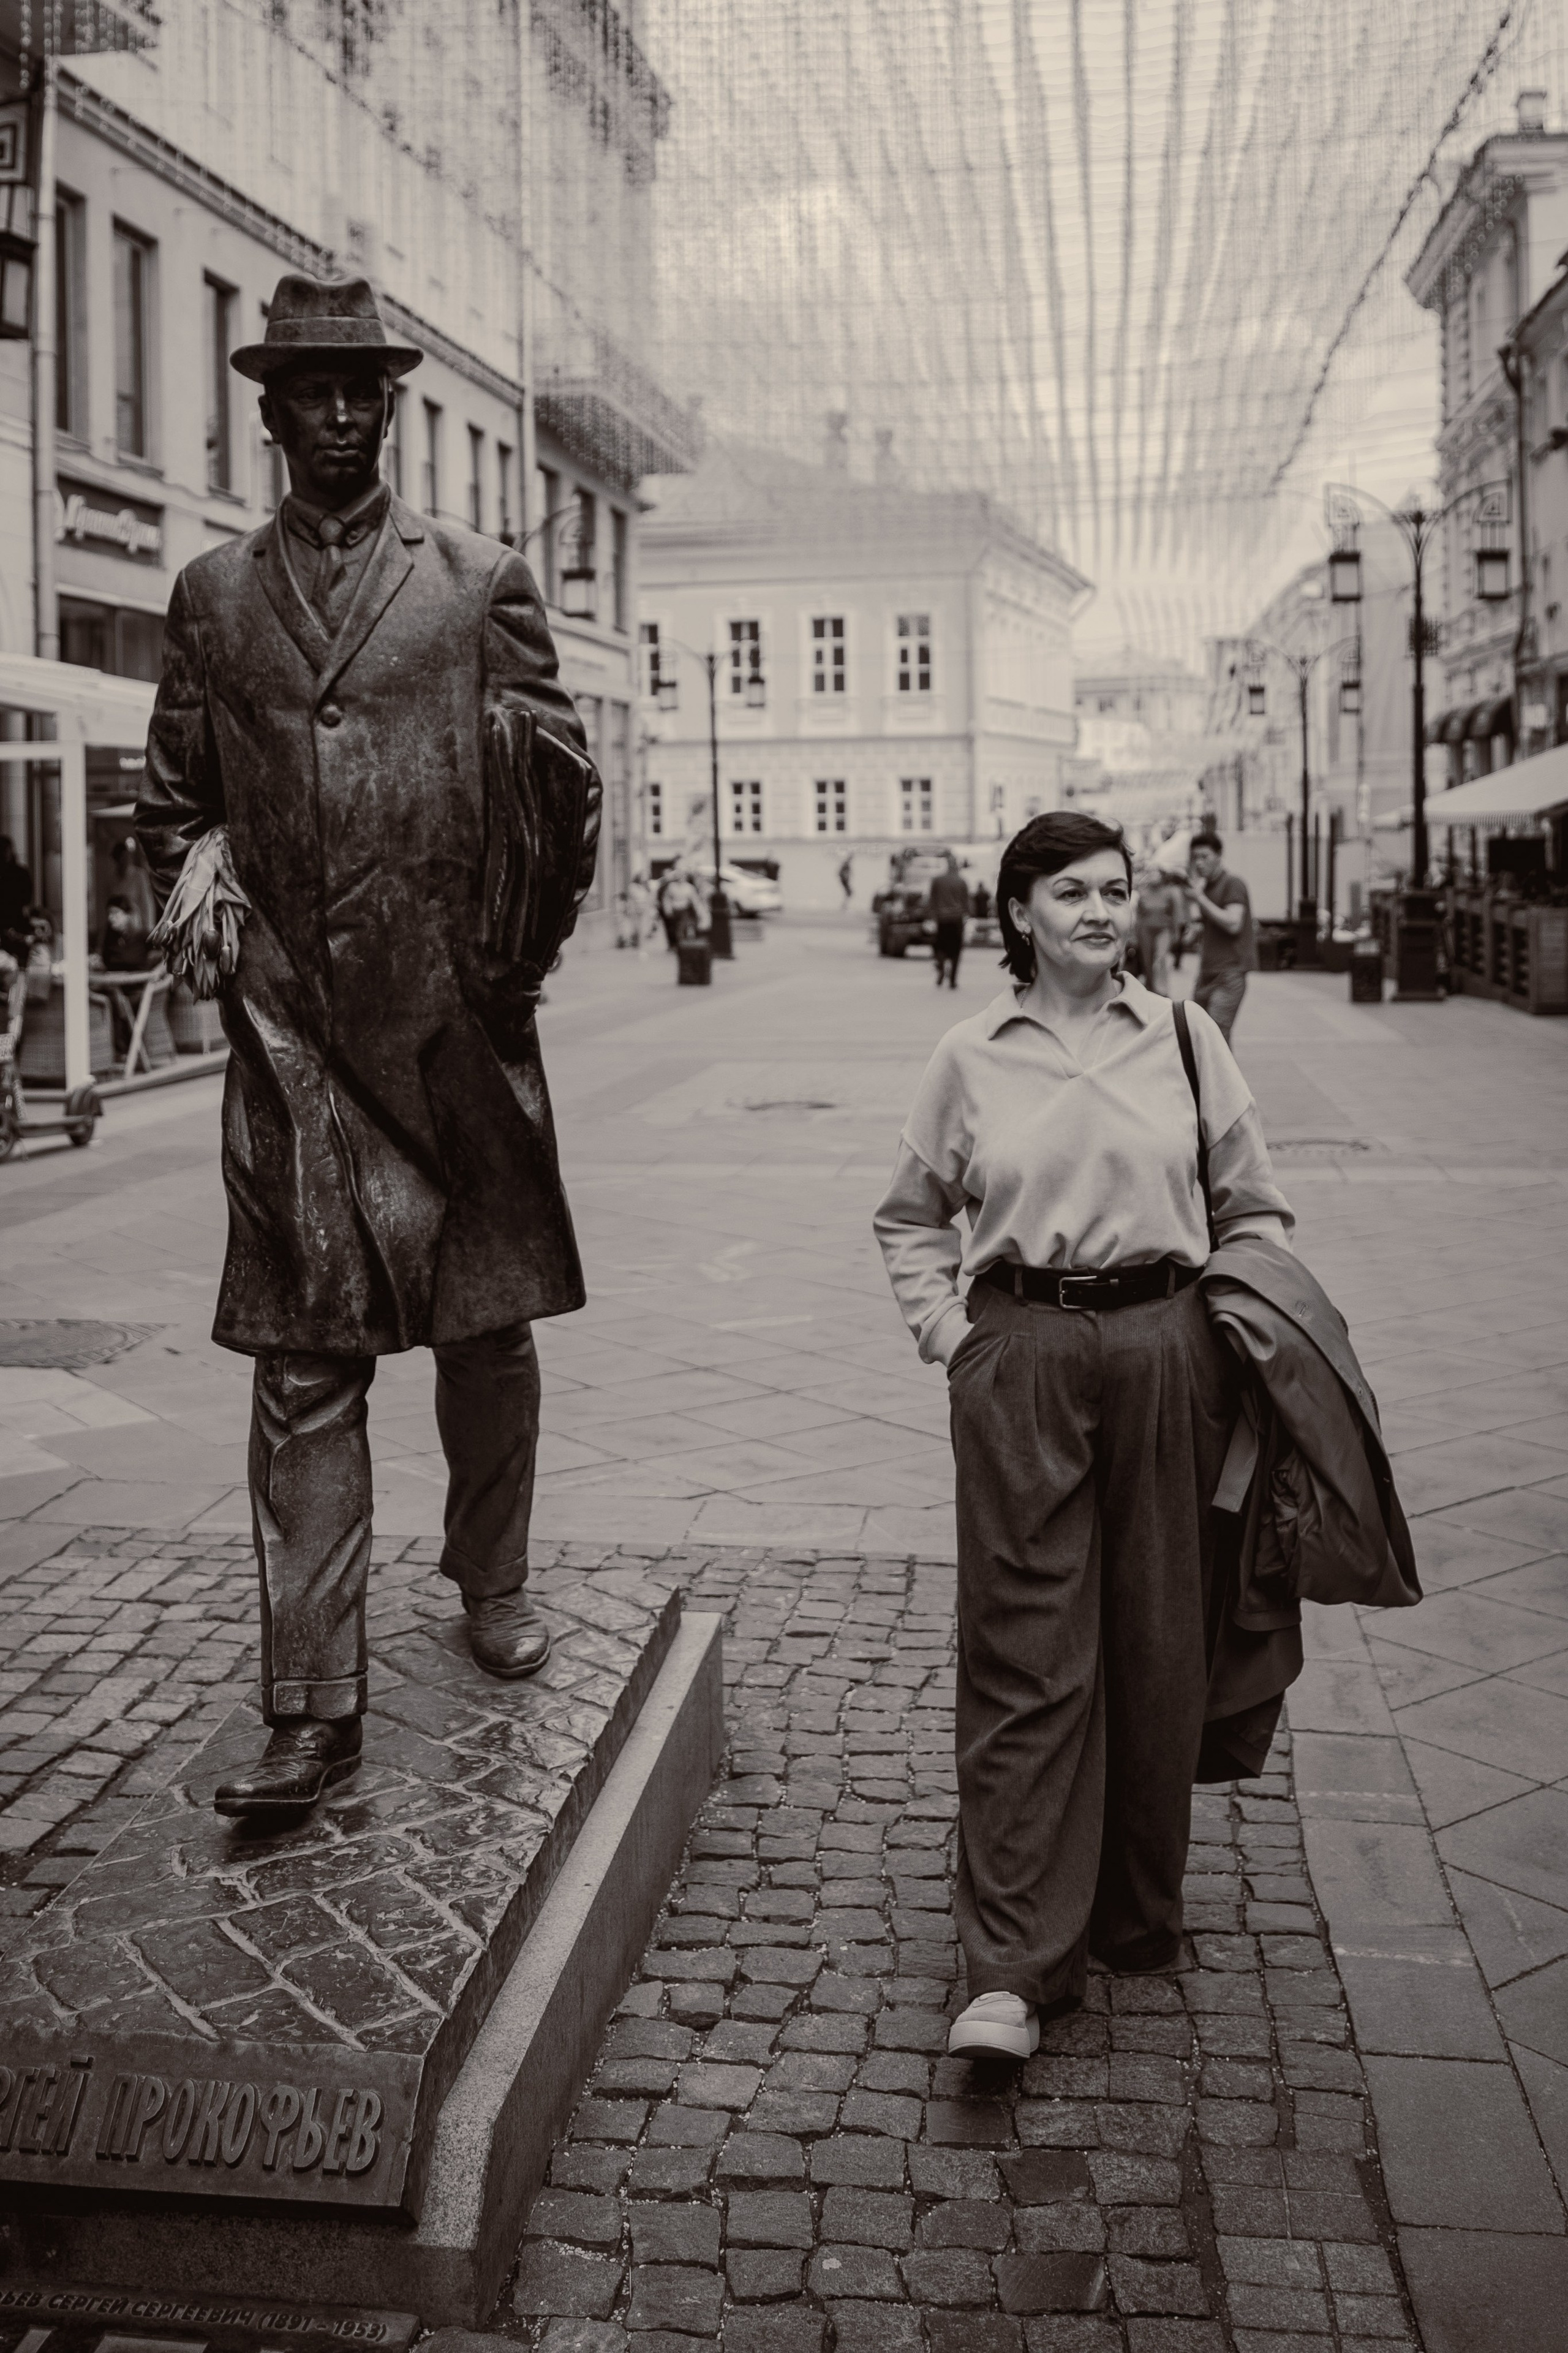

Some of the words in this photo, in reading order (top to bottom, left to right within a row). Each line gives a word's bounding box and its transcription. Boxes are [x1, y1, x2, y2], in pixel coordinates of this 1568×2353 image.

[96, 2072, 384, 2177] ПРОКОФЬЕВ
[0, 2291, 43, 2307] ЬЕВ
[48, 2293, 129, 2314] СЕРГЕЙ
[130, 2300, 255, 2325] СЕРГЕЕВИЧ
[257, 2311, 312, 2332] (1891
[333, 2319, 387, 2343] 1953)
